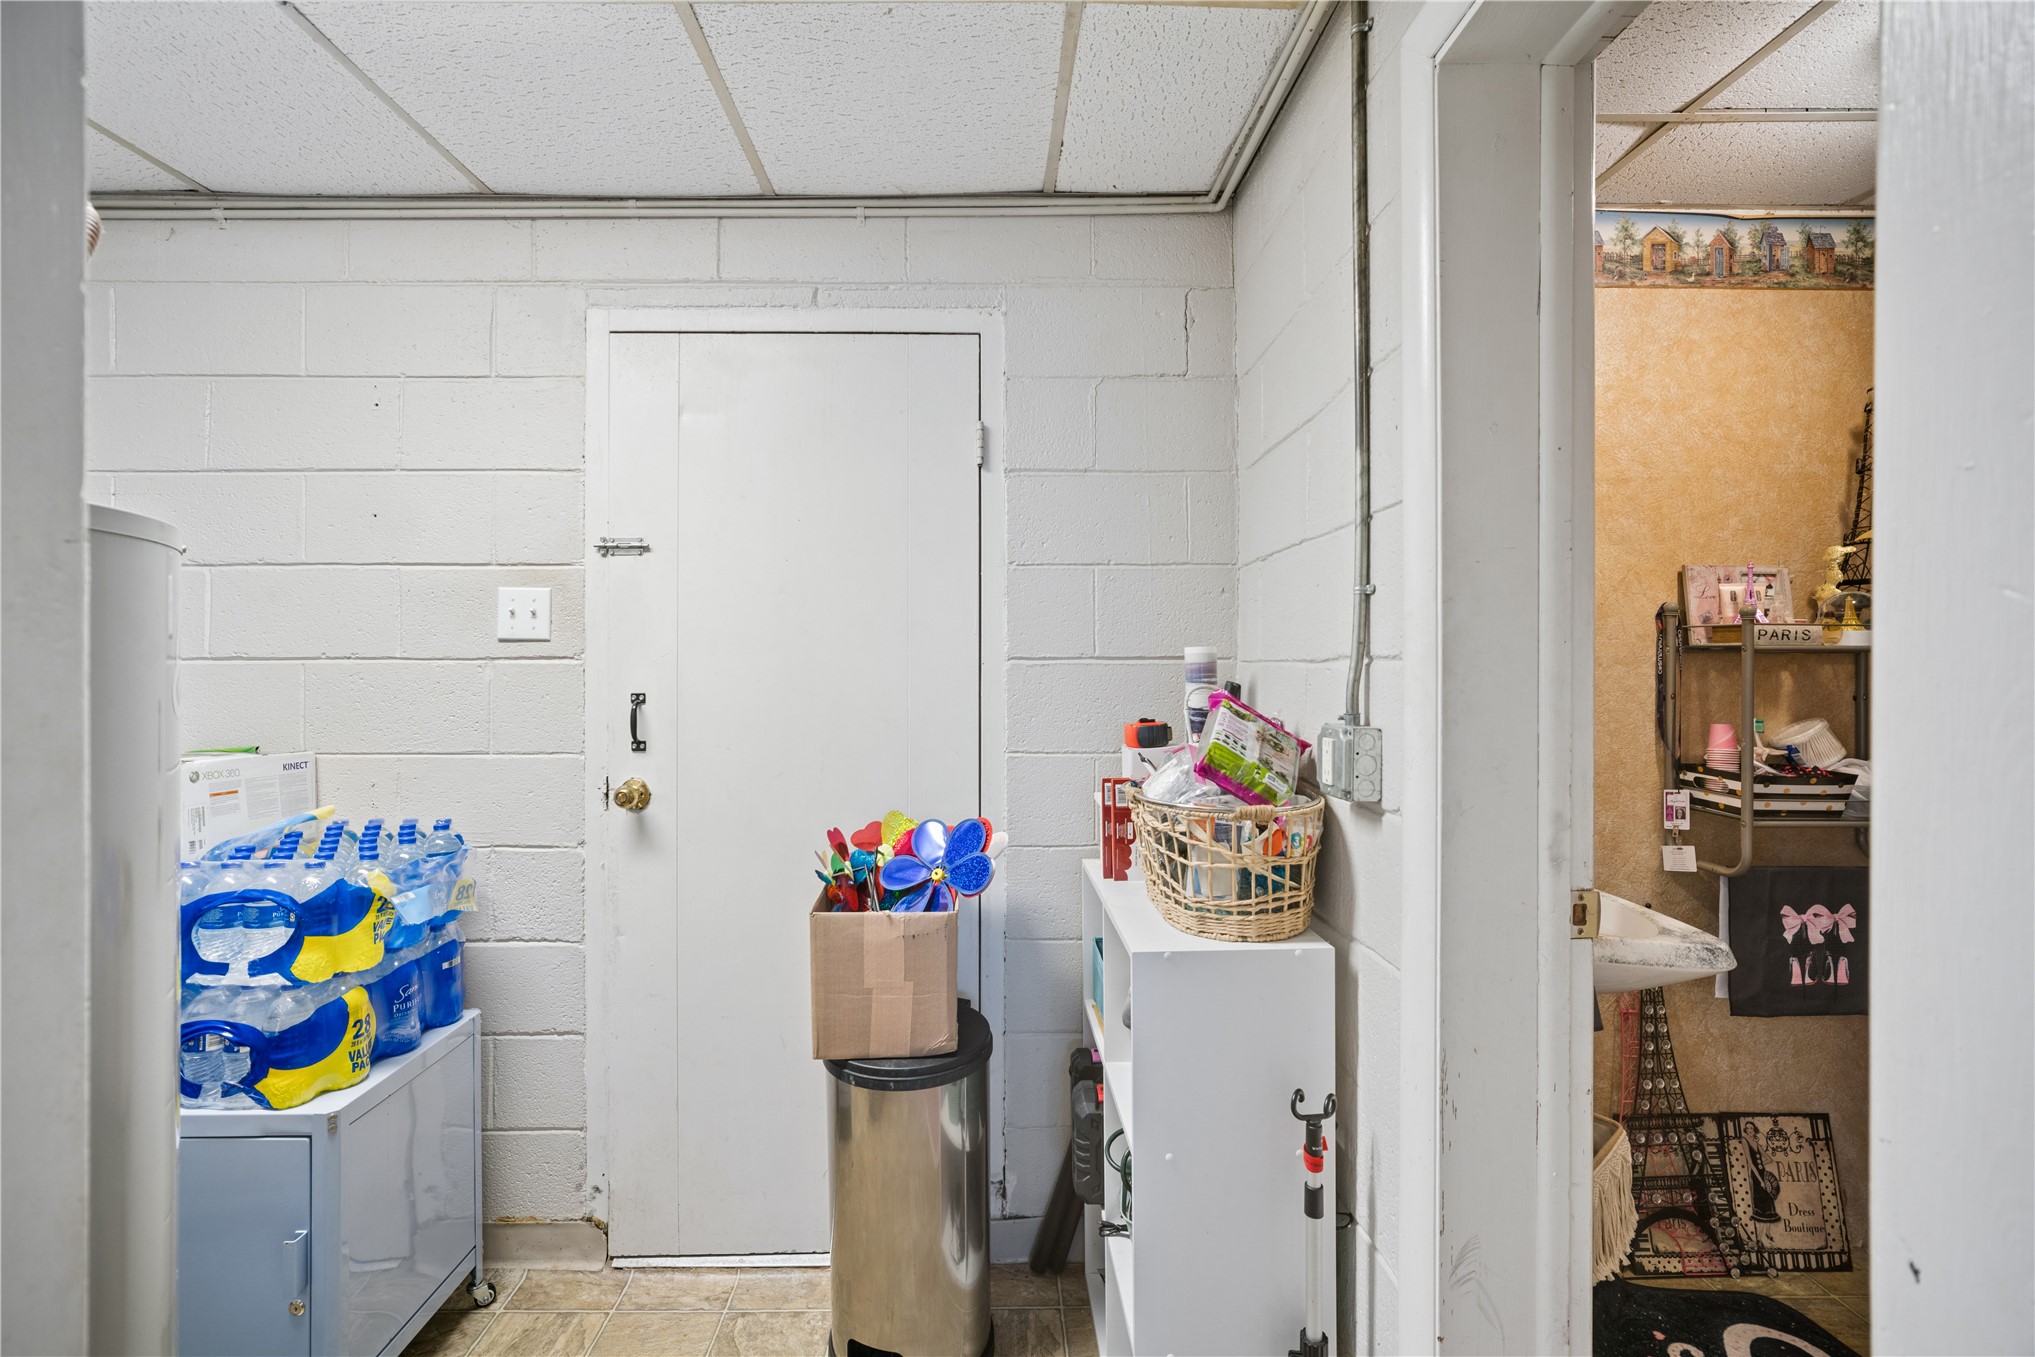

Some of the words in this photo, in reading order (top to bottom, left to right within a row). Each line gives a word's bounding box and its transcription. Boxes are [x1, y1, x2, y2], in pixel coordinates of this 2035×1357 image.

[1694, 584, 1716, 599] Love
[1757, 629, 1811, 641] PARIS
[283, 761, 308, 771] KINECT
[201, 770, 224, 780] XBOX
[225, 768, 241, 778] 360
[352, 1012, 371, 1040] 28
[1776, 1160, 1817, 1183] PARIS
[1788, 1202, 1815, 1216] Dress
[1784, 1218, 1825, 1236] Boutique
